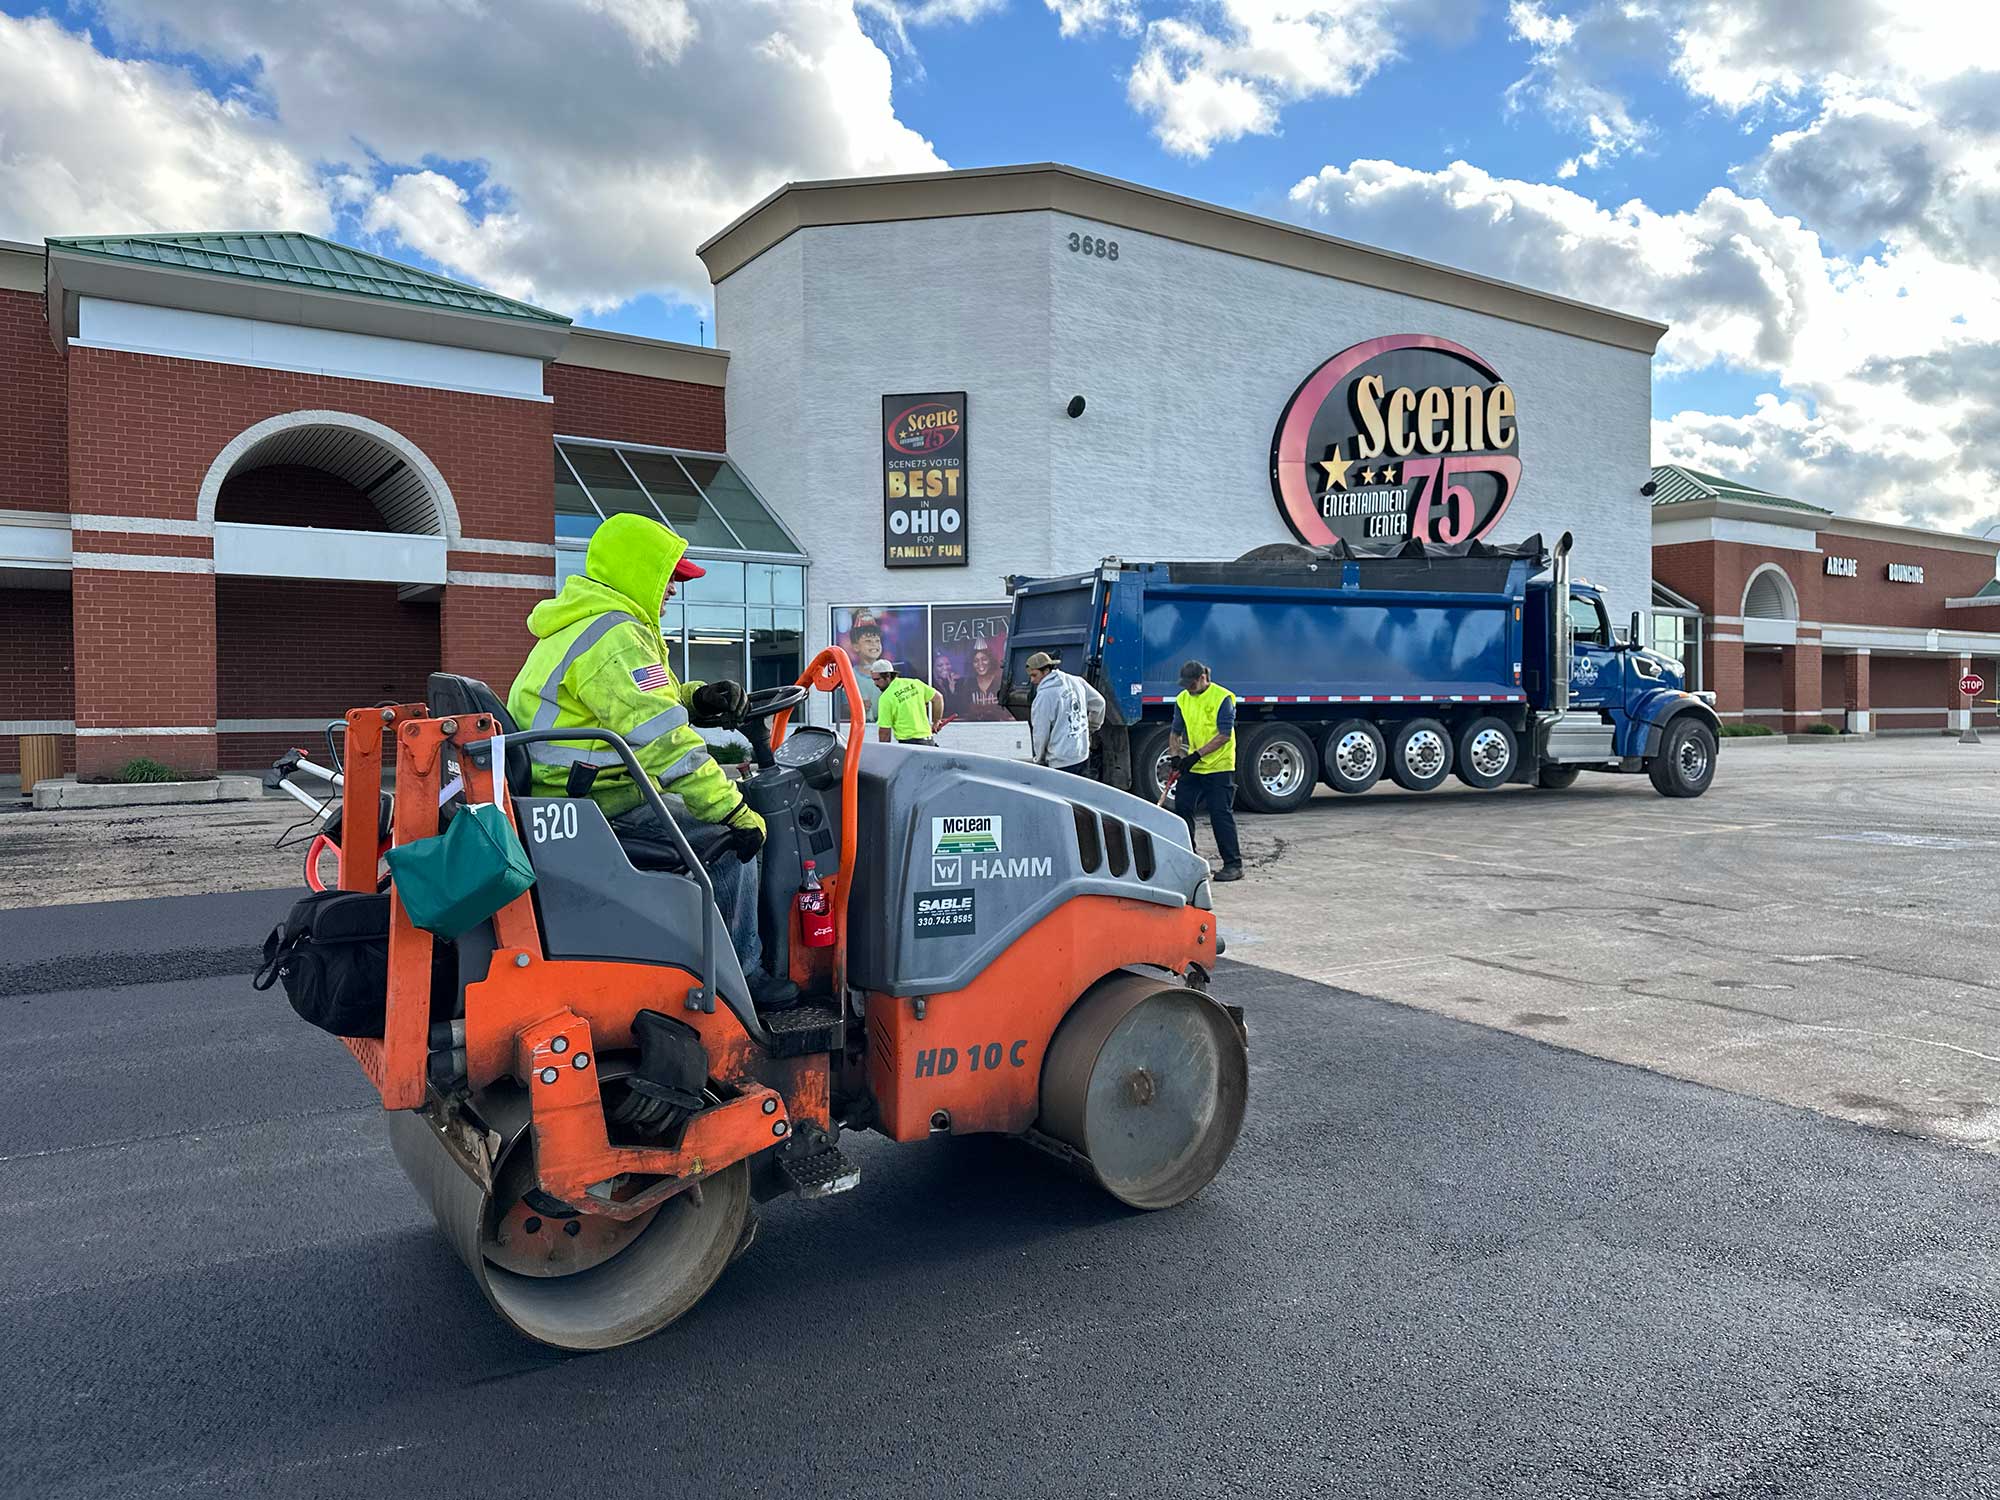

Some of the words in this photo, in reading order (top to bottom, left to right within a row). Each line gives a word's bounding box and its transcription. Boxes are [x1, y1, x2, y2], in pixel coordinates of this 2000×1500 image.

[1068, 232, 1119, 261] 3688
[908, 409, 958, 431] Scene
[1356, 374, 1516, 459] Scene
[921, 429, 945, 448] 75
[888, 460, 927, 469] SCENE75
[929, 458, 960, 467] VOTED
[888, 469, 960, 498] BEST
[920, 500, 930, 508] IN
[1323, 489, 1408, 517] ENTERTAINMENT
[1401, 455, 1477, 545] 75
[889, 508, 961, 535] OHIO
[1370, 513, 1408, 537] CENTER
[917, 535, 935, 544] FOR
[889, 546, 934, 558] FAMILY
[938, 544, 962, 557] FUN
[1826, 556, 1858, 578] ARCADE
[1888, 563, 1924, 584] BOUNCING
[1961, 679, 1982, 691] STOP
[533, 802, 578, 844] 520
[943, 817, 991, 833] McLean
[971, 856, 1052, 880] HAMM
[918, 897, 973, 911] SABLE
[917, 914, 973, 926] 330.745.9585
[915, 1047, 959, 1079] HD
[967, 1041, 1002, 1072] 10
[1010, 1039, 1028, 1067] C
